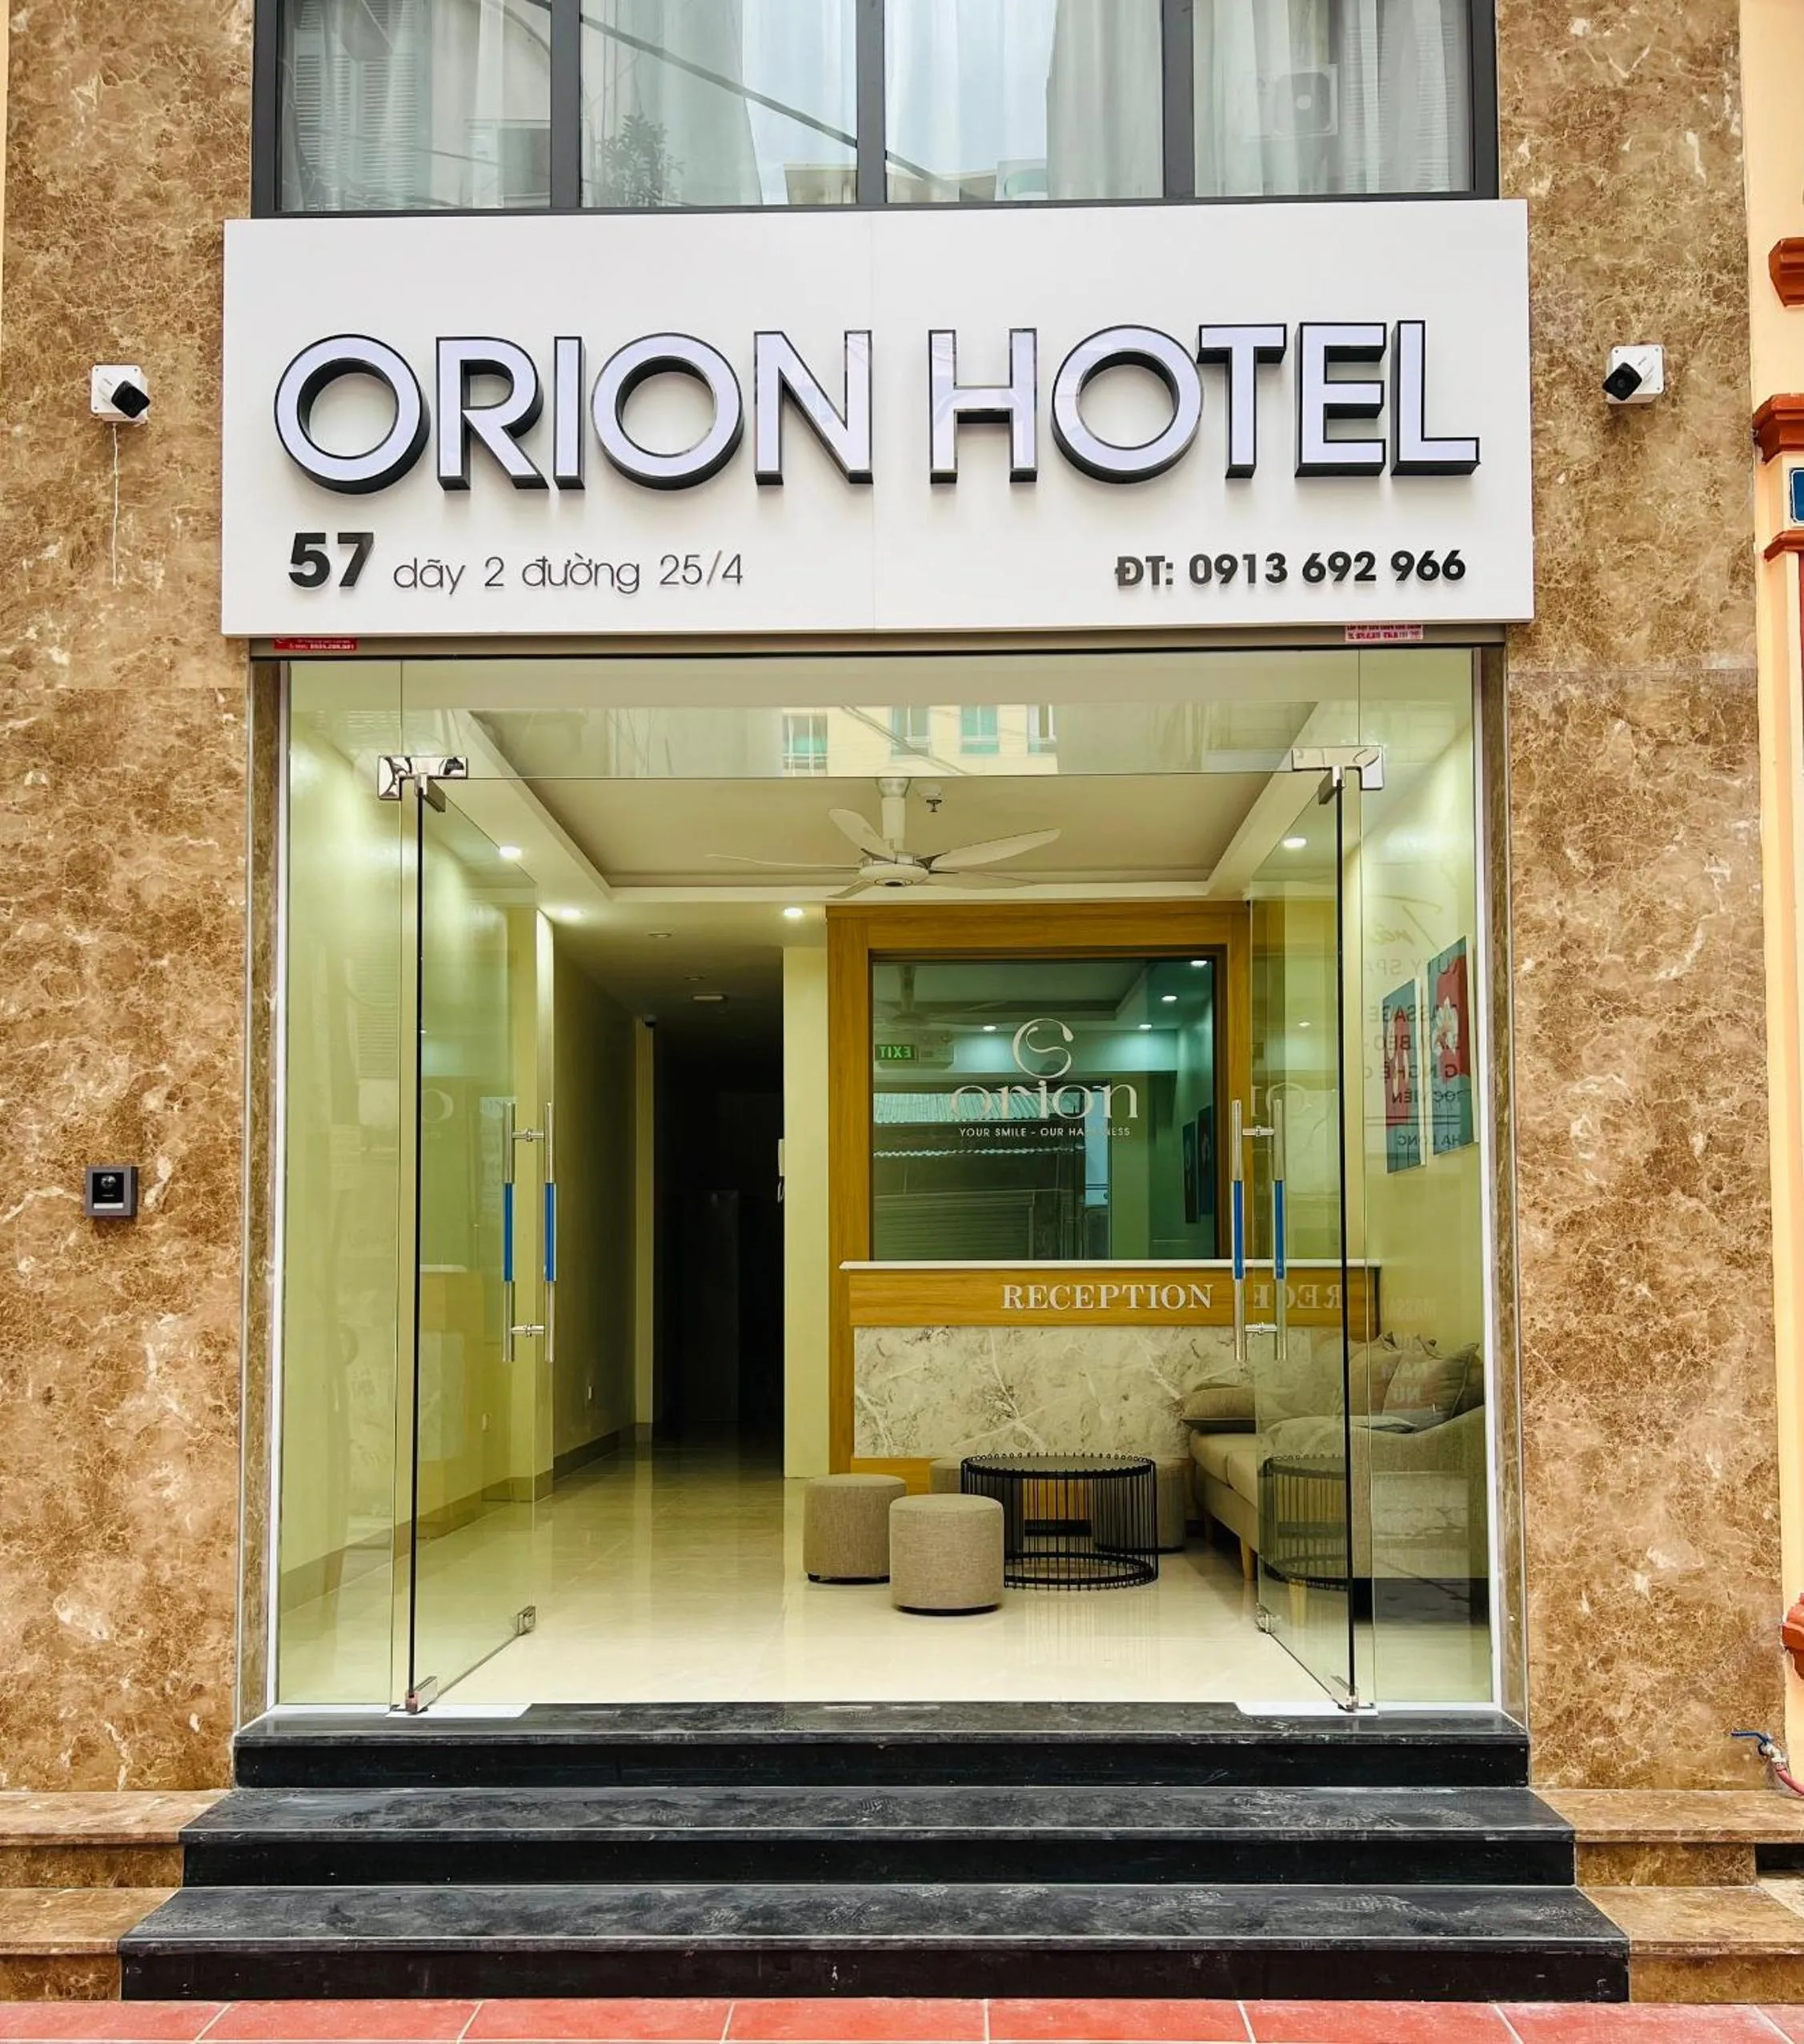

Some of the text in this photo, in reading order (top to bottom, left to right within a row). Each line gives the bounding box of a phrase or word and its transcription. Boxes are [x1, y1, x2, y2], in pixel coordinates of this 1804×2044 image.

[274, 320, 1480, 495] ORION HOTEL
[287, 531, 744, 595] 57 dãy 2 đường 25/4
[1114, 550, 1466, 587] ĐT: 0913 692 966
[950, 1080, 1138, 1120] orion
[960, 1127, 991, 1137] YOUR
[995, 1127, 1027, 1137] SMILE
[1040, 1127, 1064, 1136] OUR
[1000, 1284, 1214, 1310] RECEPTION
